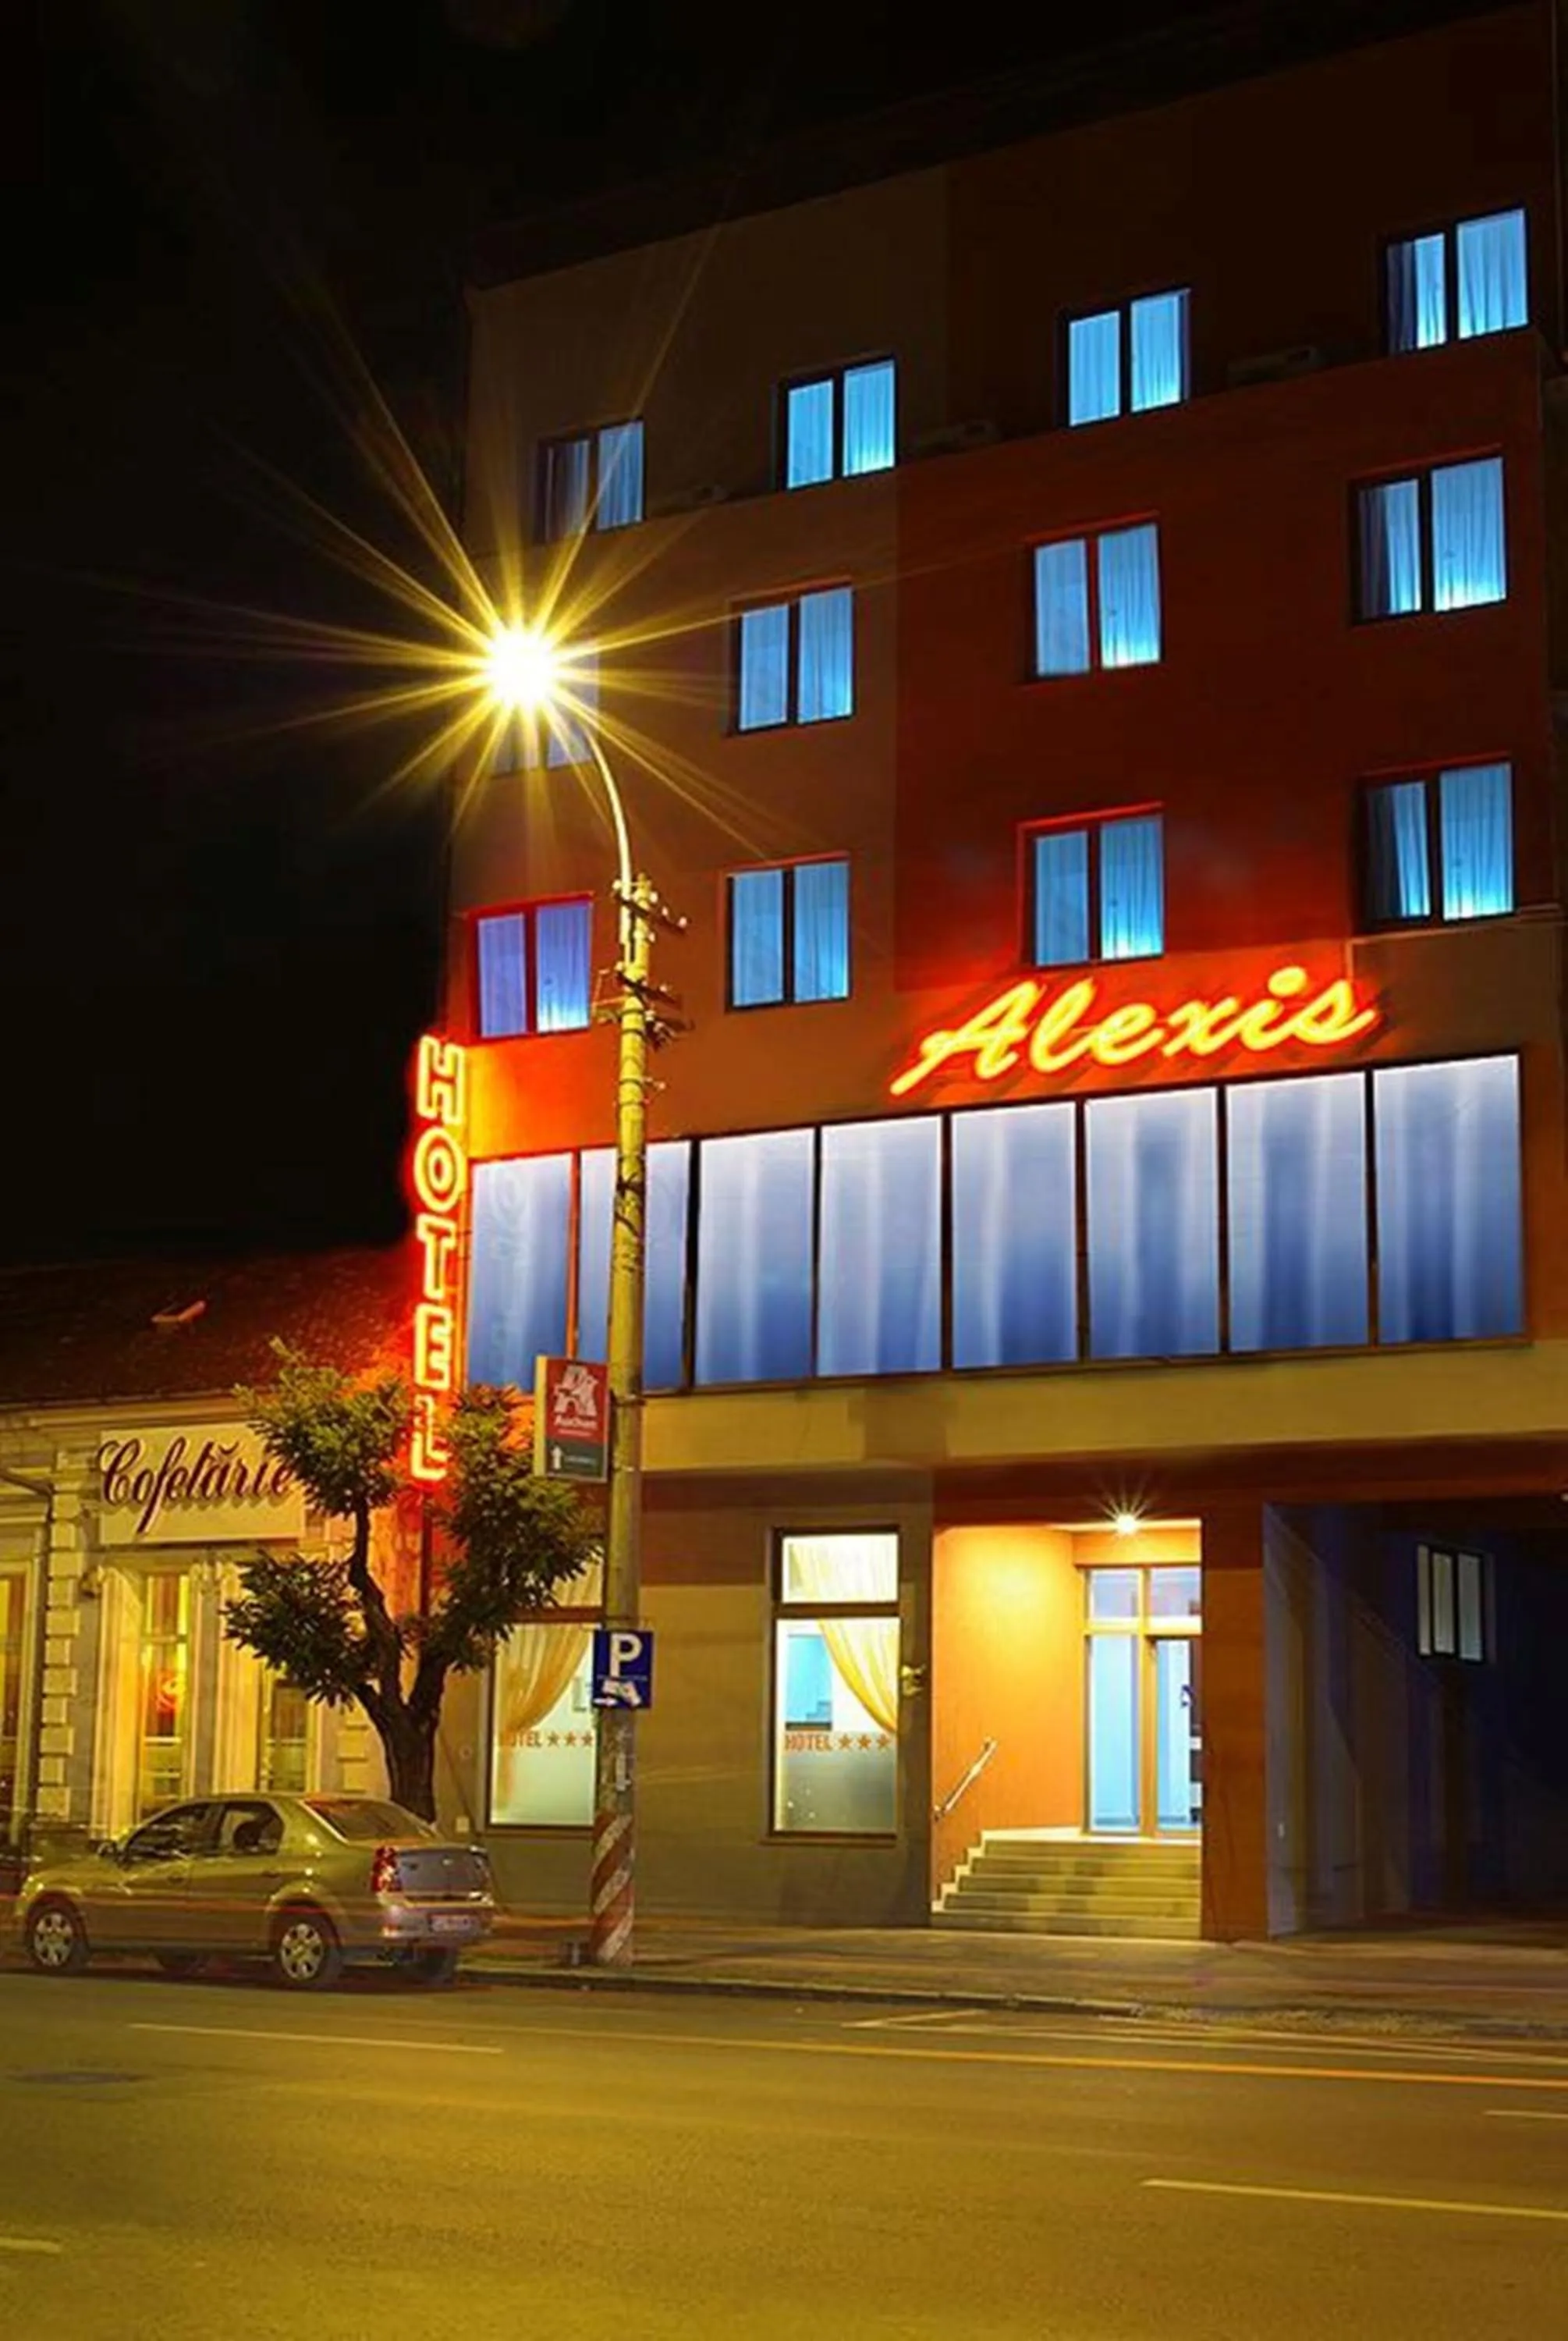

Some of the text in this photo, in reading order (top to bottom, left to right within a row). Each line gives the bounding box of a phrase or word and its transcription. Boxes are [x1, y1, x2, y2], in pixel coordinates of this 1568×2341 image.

[890, 965, 1376, 1096] Alexis
[411, 1036, 466, 1480] HOTEL
[610, 1633, 642, 1677] P
[785, 1734, 832, 1750] HOTEL
